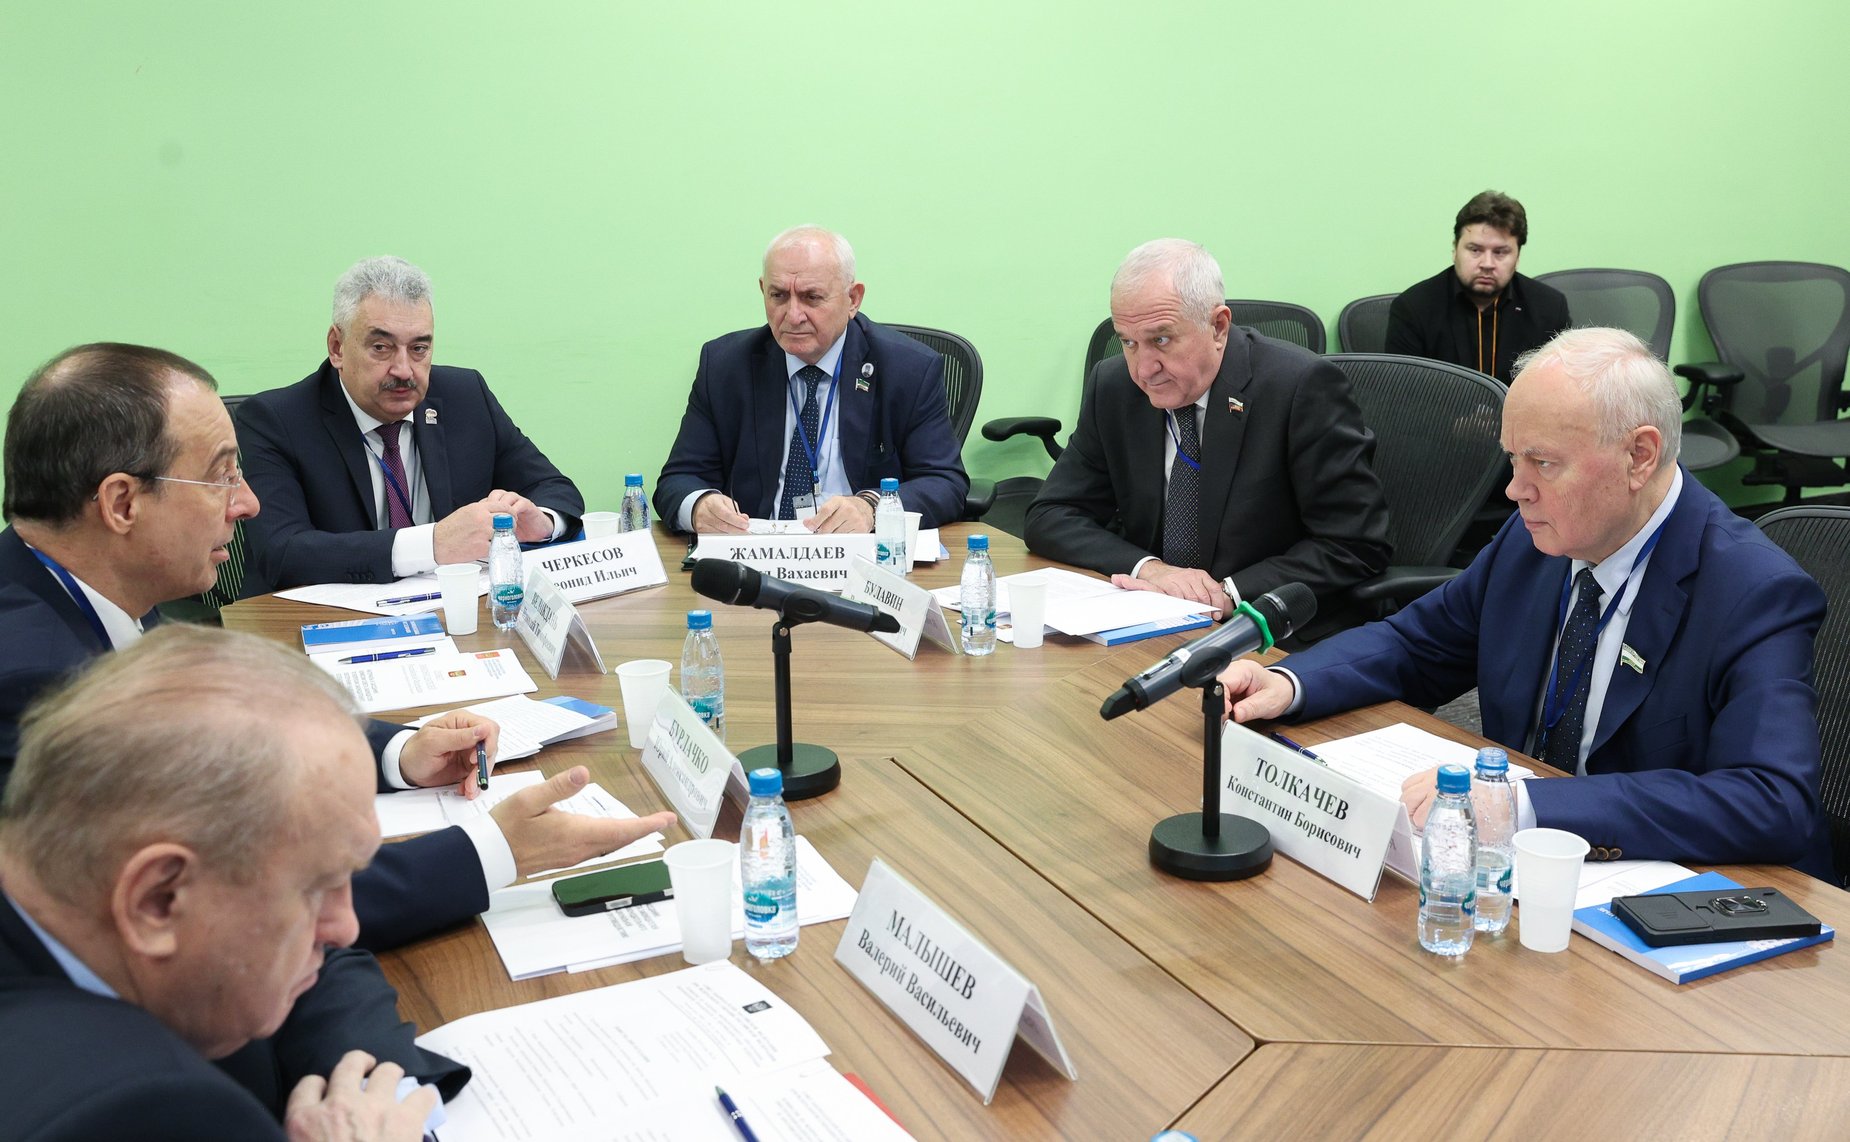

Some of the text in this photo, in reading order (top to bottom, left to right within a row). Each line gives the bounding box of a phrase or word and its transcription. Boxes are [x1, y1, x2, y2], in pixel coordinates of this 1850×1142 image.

[542, 546, 624, 573] ЧЕРКЕСОВ
[730, 546, 845, 561] ЖАМАЛДАЕВ
[777, 567, 848, 580] Вахаевич
[553, 566, 638, 591] еонид Ильич
[864, 580, 904, 611] БУЛАВИН
[669, 719, 710, 775] БУРЛАЧКО
[1254, 757, 1350, 822] ТОЛКАЧЕВ
[1227, 775, 1362, 859] Константин Борисович
[886, 909, 976, 1000] МАЛЫШЕВ
[857, 928, 982, 1054] Валерий Васильевич
